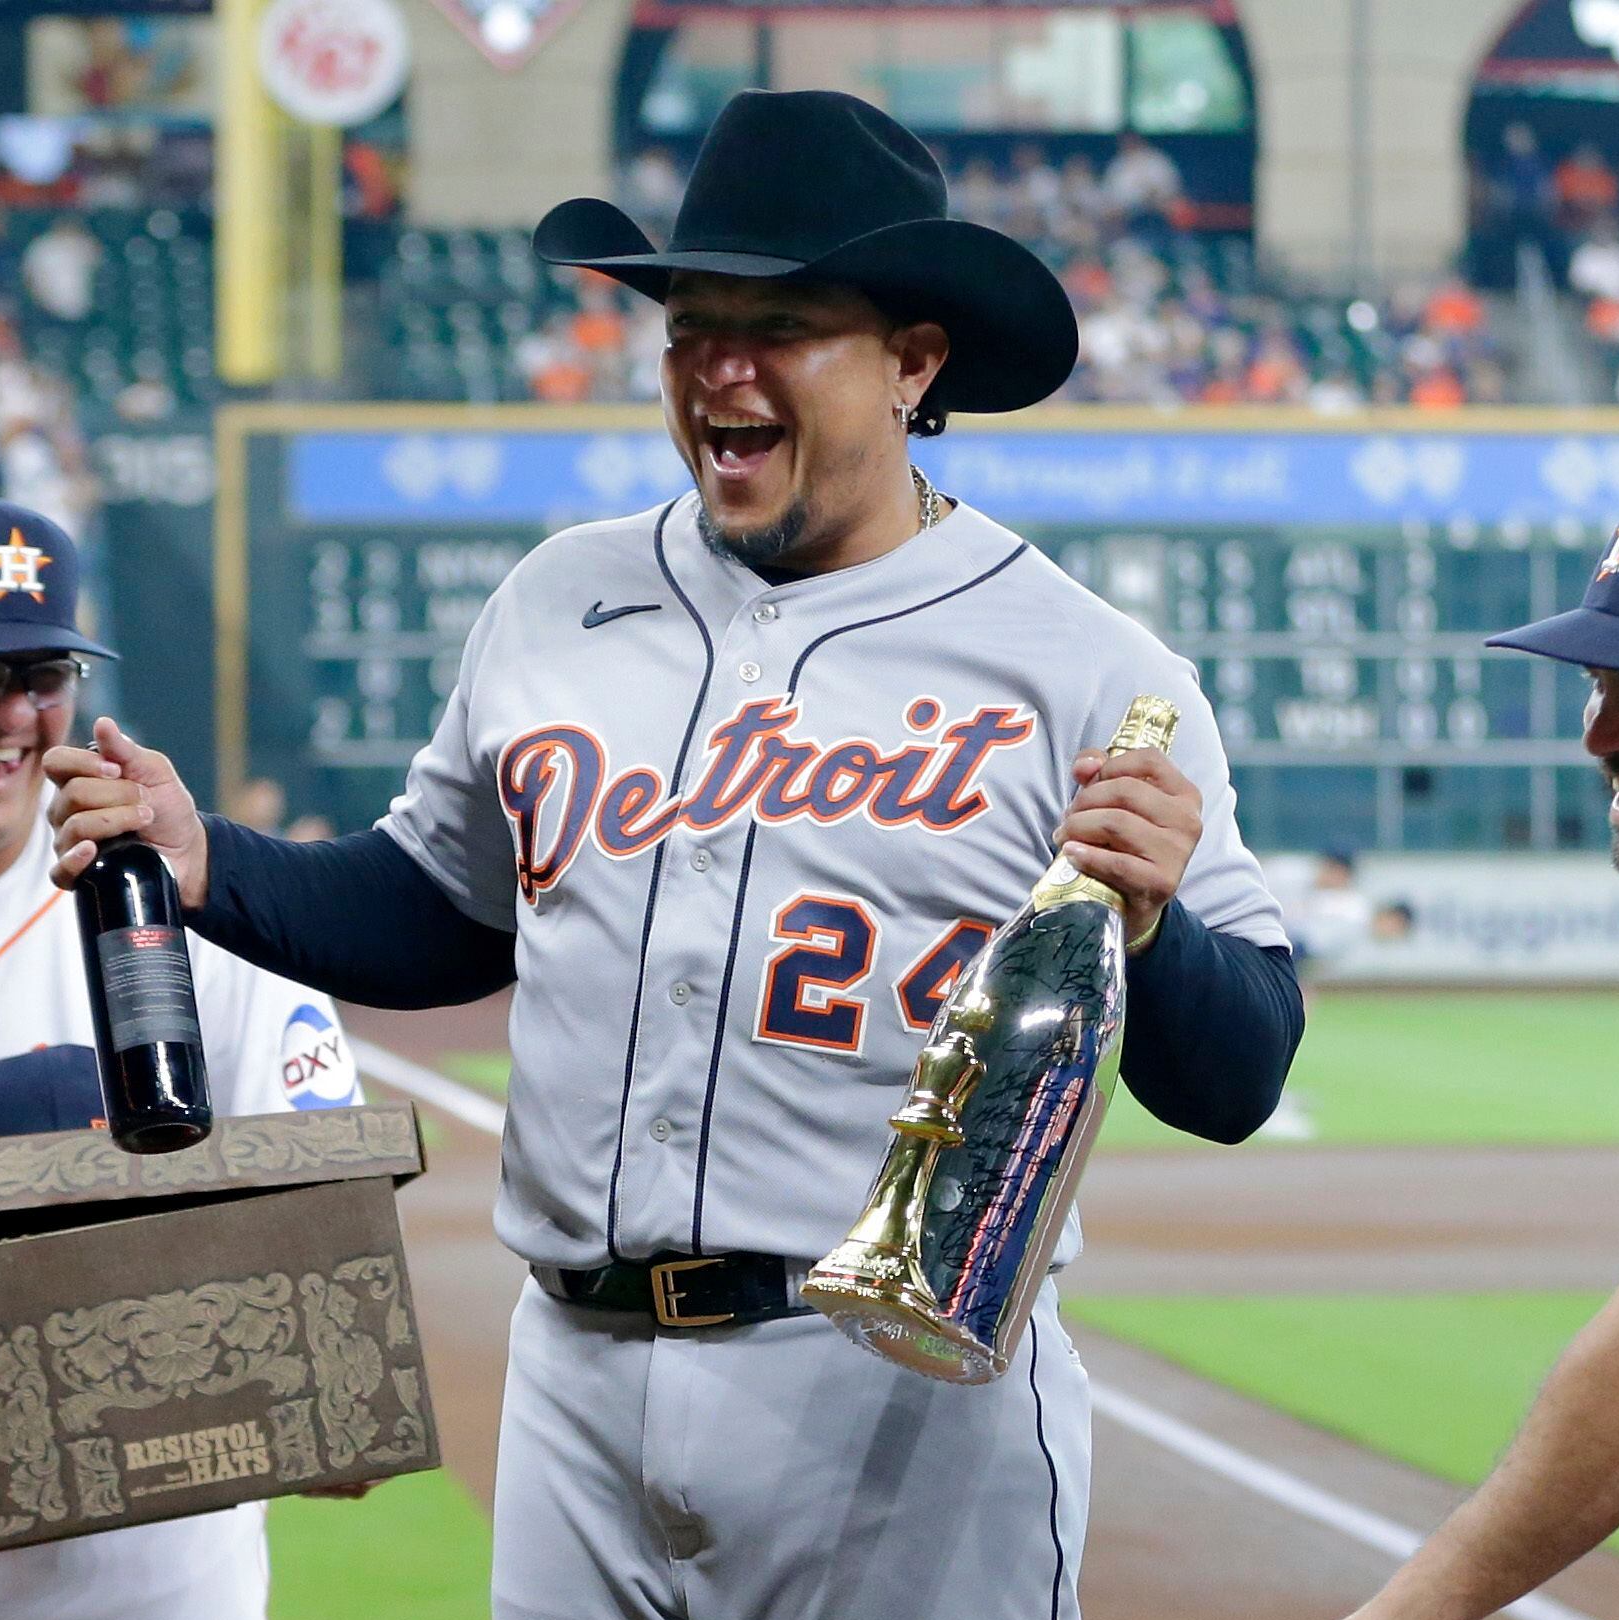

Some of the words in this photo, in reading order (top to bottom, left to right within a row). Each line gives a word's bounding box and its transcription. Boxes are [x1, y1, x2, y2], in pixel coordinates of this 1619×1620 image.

[496, 691, 1038, 906] Detroit
[282, 1036, 342, 1089] OXY
[123, 1420, 266, 1471] RESISTOL
[188, 1447, 271, 1485] HATS
